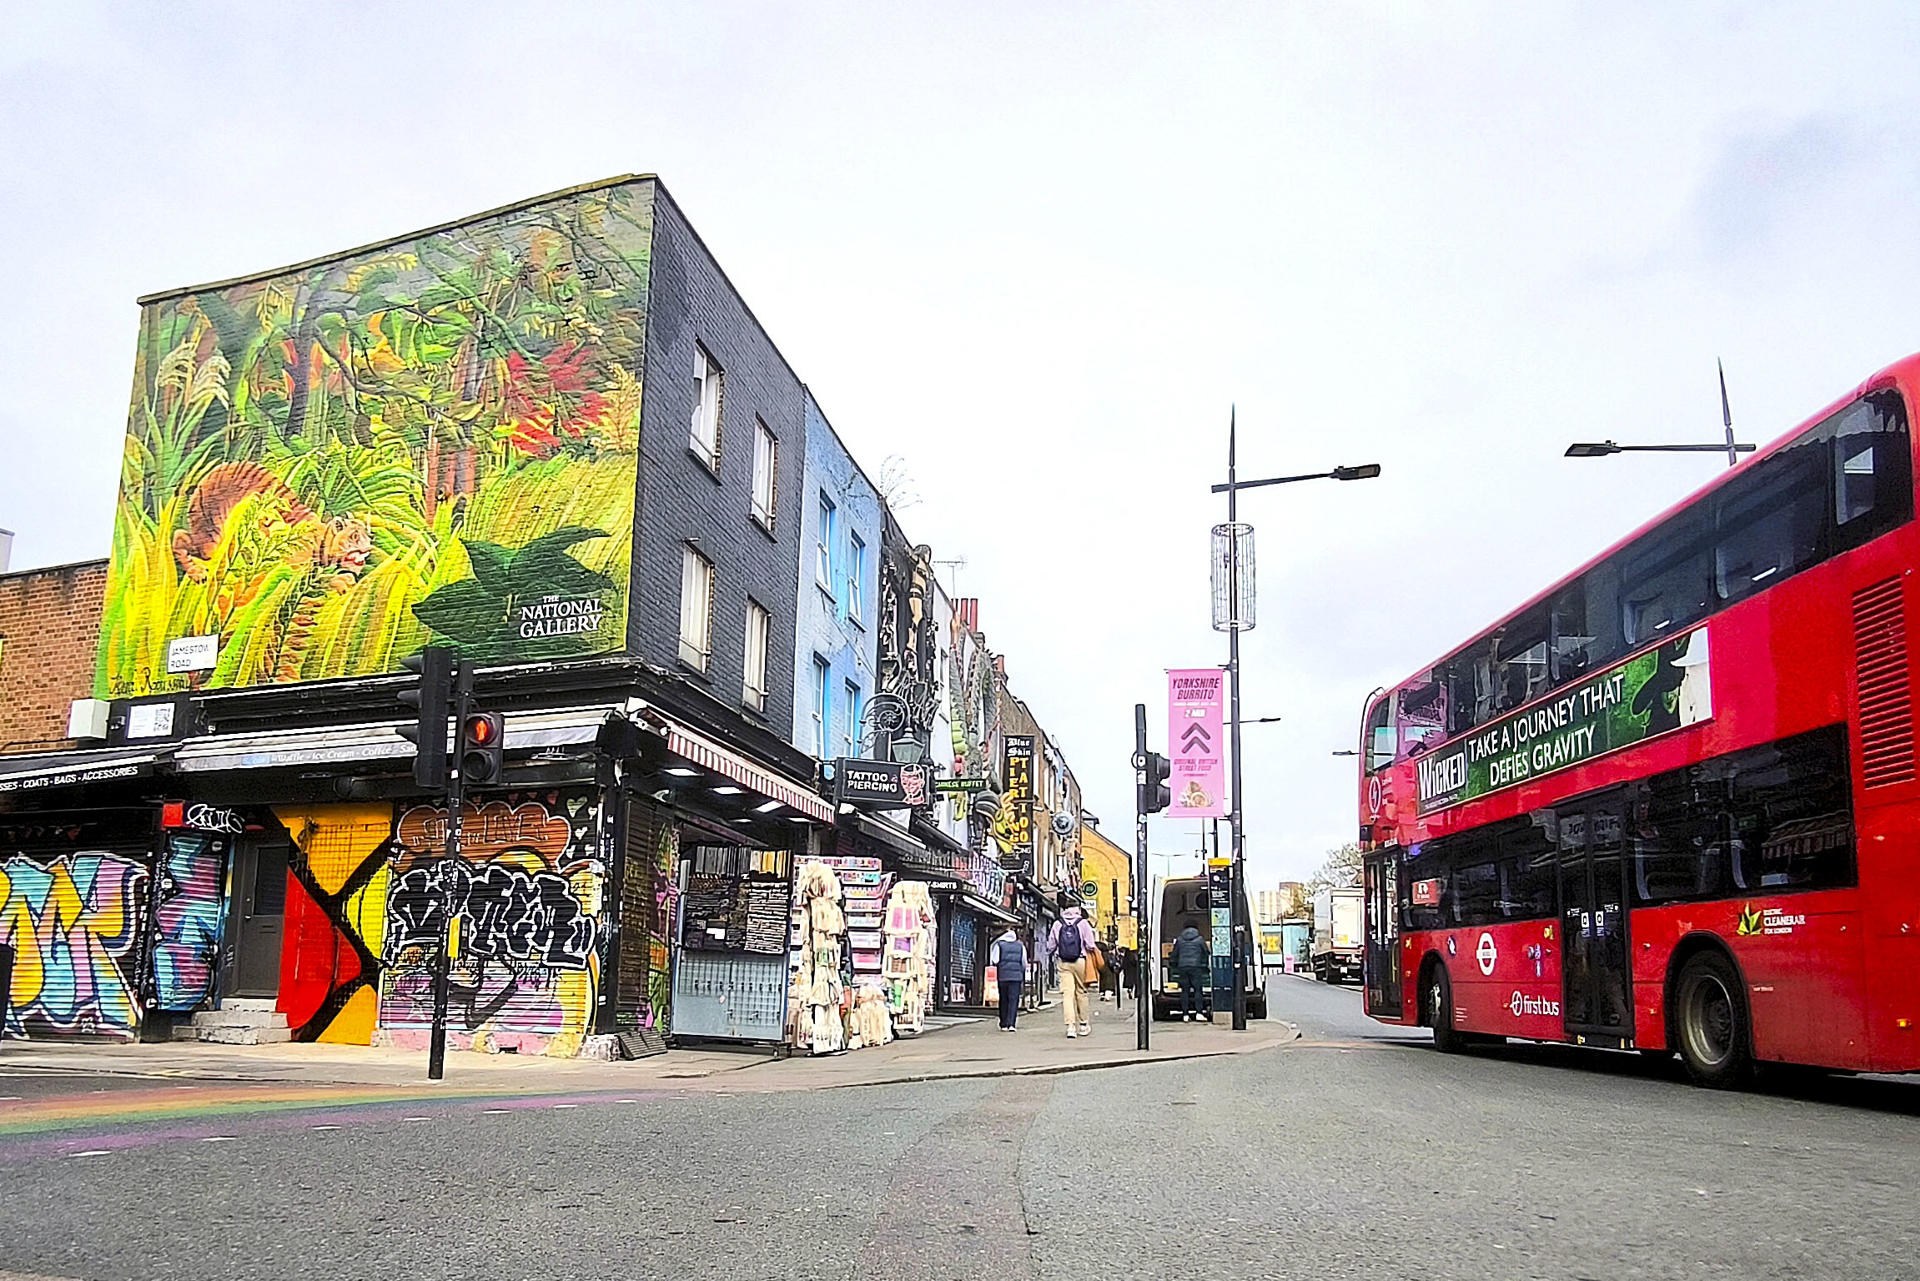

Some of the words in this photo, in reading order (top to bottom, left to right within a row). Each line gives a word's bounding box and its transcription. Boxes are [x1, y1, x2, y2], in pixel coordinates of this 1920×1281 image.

[542, 595, 560, 604] THE
[520, 598, 602, 621] NATIONAL
[520, 614, 602, 638] GALLERY
[171, 643, 210, 656] JAMESTOW
[170, 658, 192, 668] ROAD
[1172, 677, 1220, 689] YORKSHIRE
[1177, 689, 1215, 700] BURRITO
[1468, 729, 1499, 763] TAKE
[1500, 729, 1511, 751] A
[1512, 694, 1576, 752] JOURNEY
[1579, 674, 1624, 717] THAT
[1007, 738, 1030, 747] Blue
[311, 752, 325, 761] Ice
[327, 750, 355, 760] Cream
[361, 746, 393, 757] Coffee
[1007, 748, 1031, 757] Skin
[1489, 752, 1530, 787] DEFIES
[1532, 723, 1597, 771] GRAVITY
[23, 777, 50, 789] COATS
[54, 774, 77, 785] BAGS
[81, 766, 138, 781] ACCESSORIES
[847, 770, 888, 782] TATTOO
[1417, 751, 1466, 801] WICKED
[847, 781, 898, 793] PIERCING
[1009, 757, 1021, 843] PIERNG
[1018, 757, 1029, 843] TATTOO
